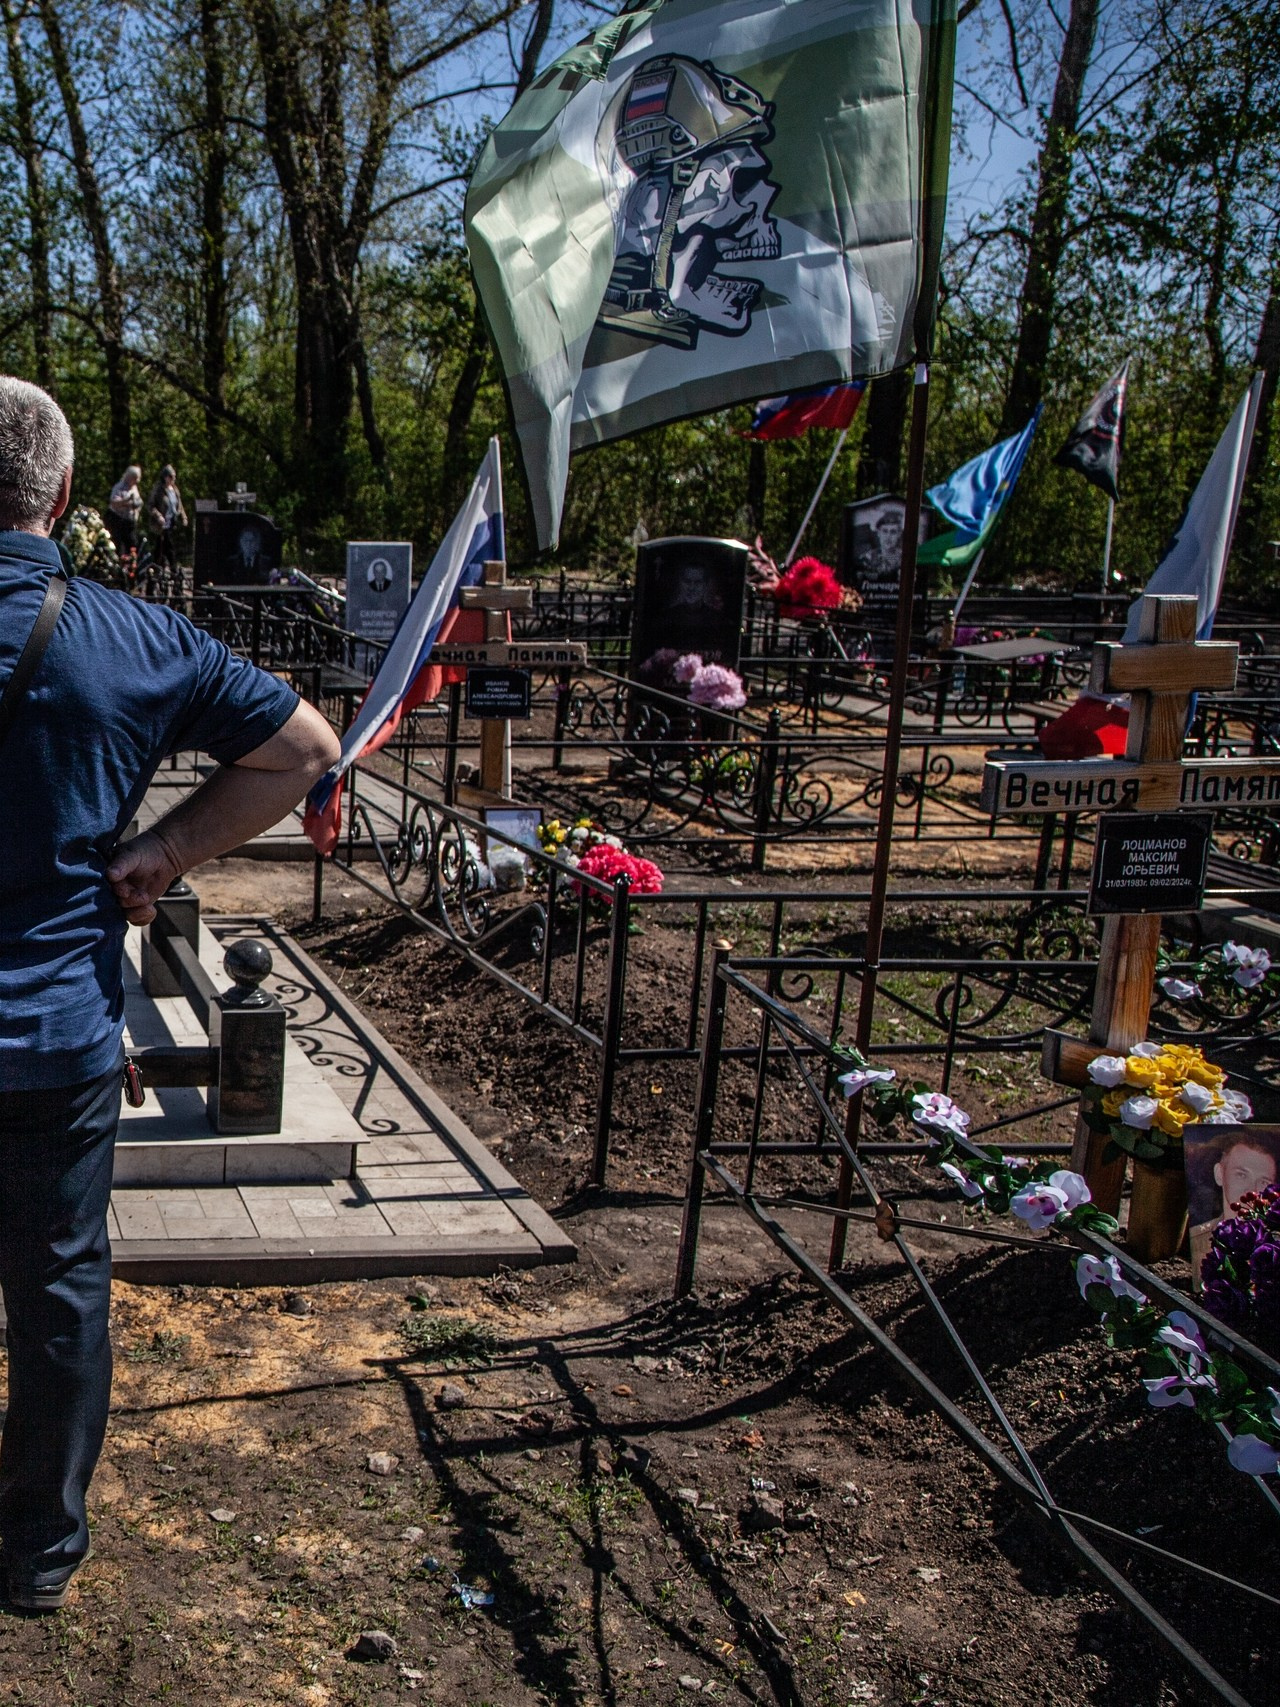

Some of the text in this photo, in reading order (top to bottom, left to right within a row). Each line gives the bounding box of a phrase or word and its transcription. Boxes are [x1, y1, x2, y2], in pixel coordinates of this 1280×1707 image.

[431, 648, 580, 662] ечная Память
[1006, 772, 1140, 808] Вечная
[1121, 838, 1187, 852] ЛОЦМАНОВ
[1128, 852, 1177, 863] МАКСИМ
[1122, 864, 1180, 876] ЮРЬЕВИЧ
